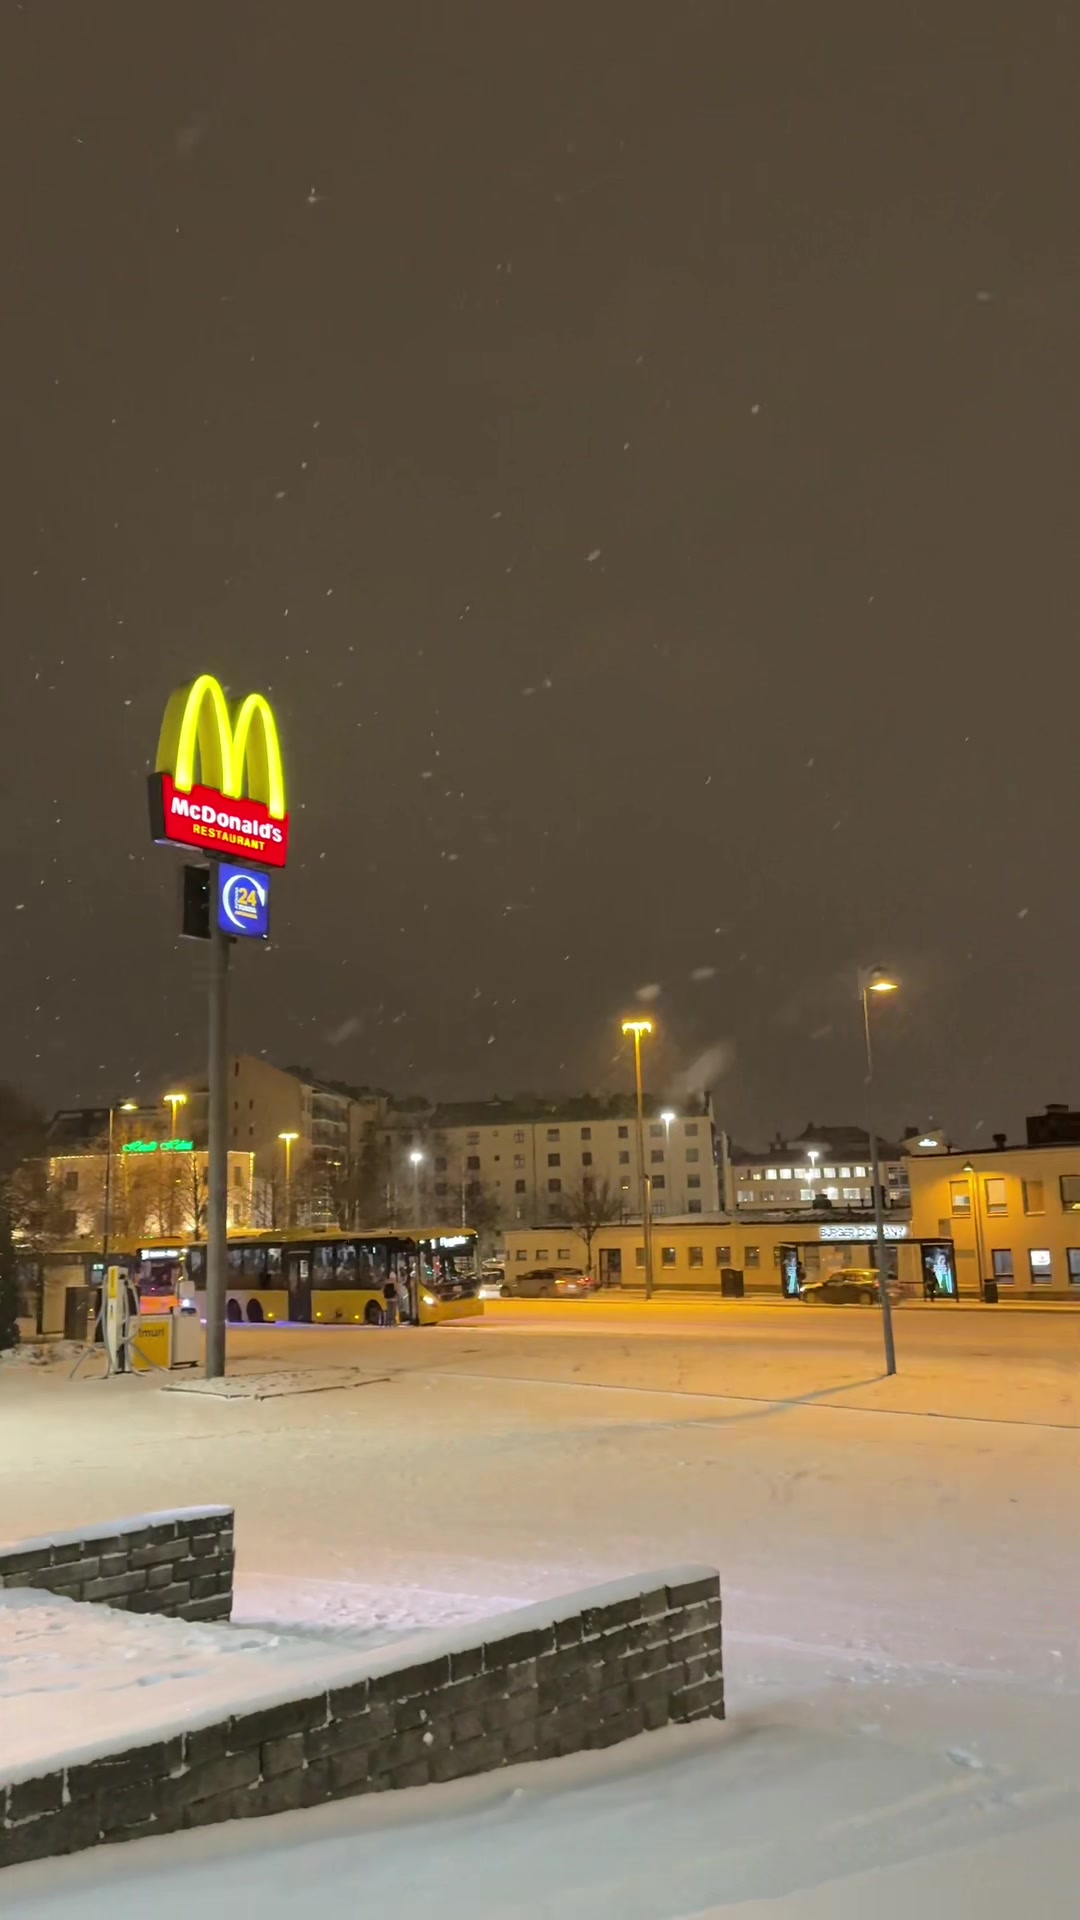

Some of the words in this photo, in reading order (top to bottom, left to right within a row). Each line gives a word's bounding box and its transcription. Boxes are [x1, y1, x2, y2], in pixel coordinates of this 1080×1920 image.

[171, 797, 283, 843] McDonald's
[193, 824, 265, 851] RESTAURANT
[237, 887, 257, 907] 24
[820, 1228, 855, 1238] BURGER
[857, 1227, 904, 1237] COMANY
